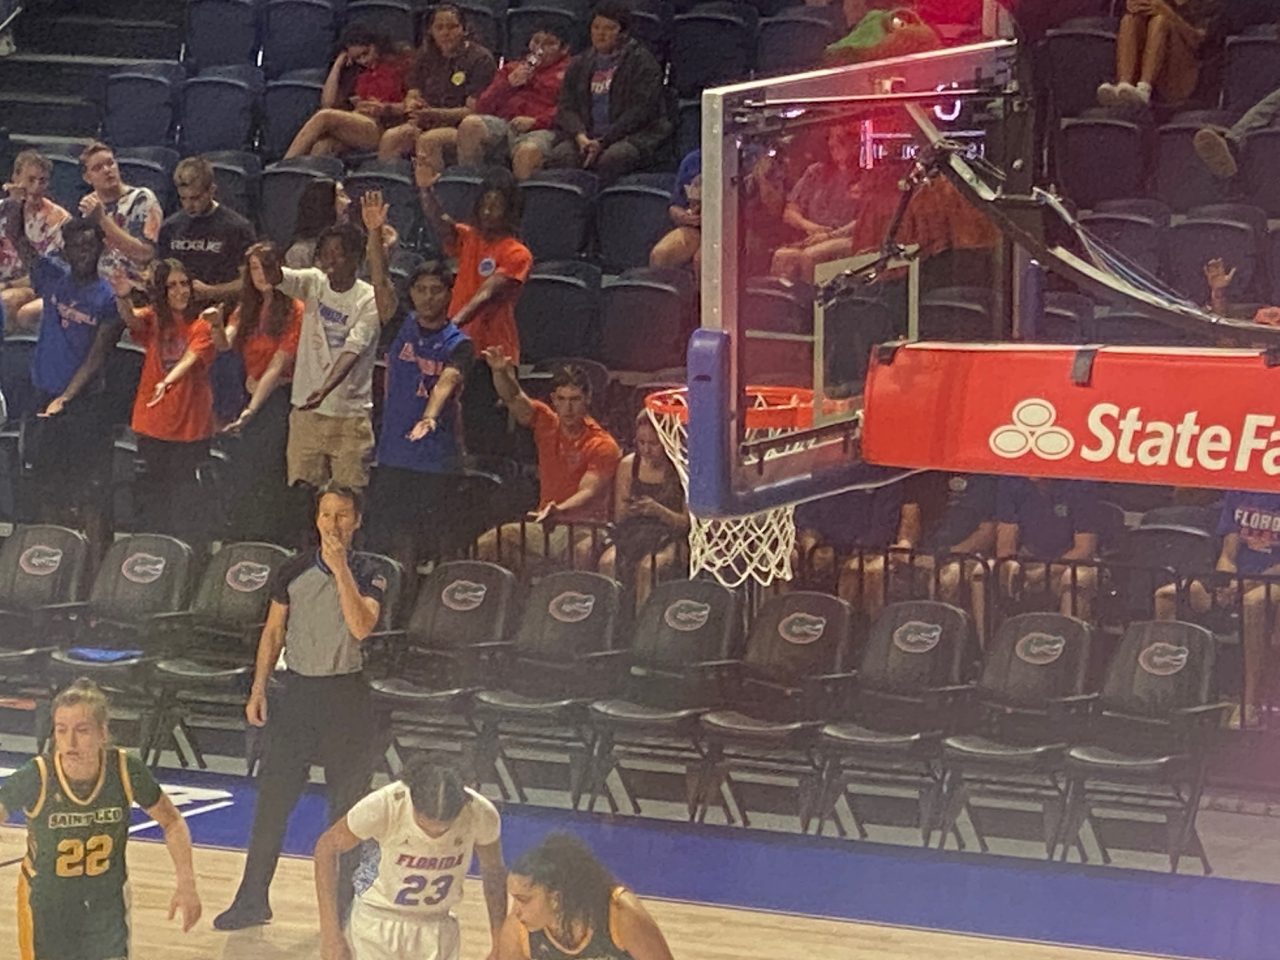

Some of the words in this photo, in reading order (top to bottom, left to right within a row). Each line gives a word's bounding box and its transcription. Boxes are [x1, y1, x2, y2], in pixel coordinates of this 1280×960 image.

[170, 239, 223, 253] ROGUE
[48, 812, 95, 829] SAINT
[94, 807, 123, 823] LEO
[56, 834, 113, 877] 22
[395, 853, 464, 870] FLORIDA
[394, 875, 454, 906] 23
